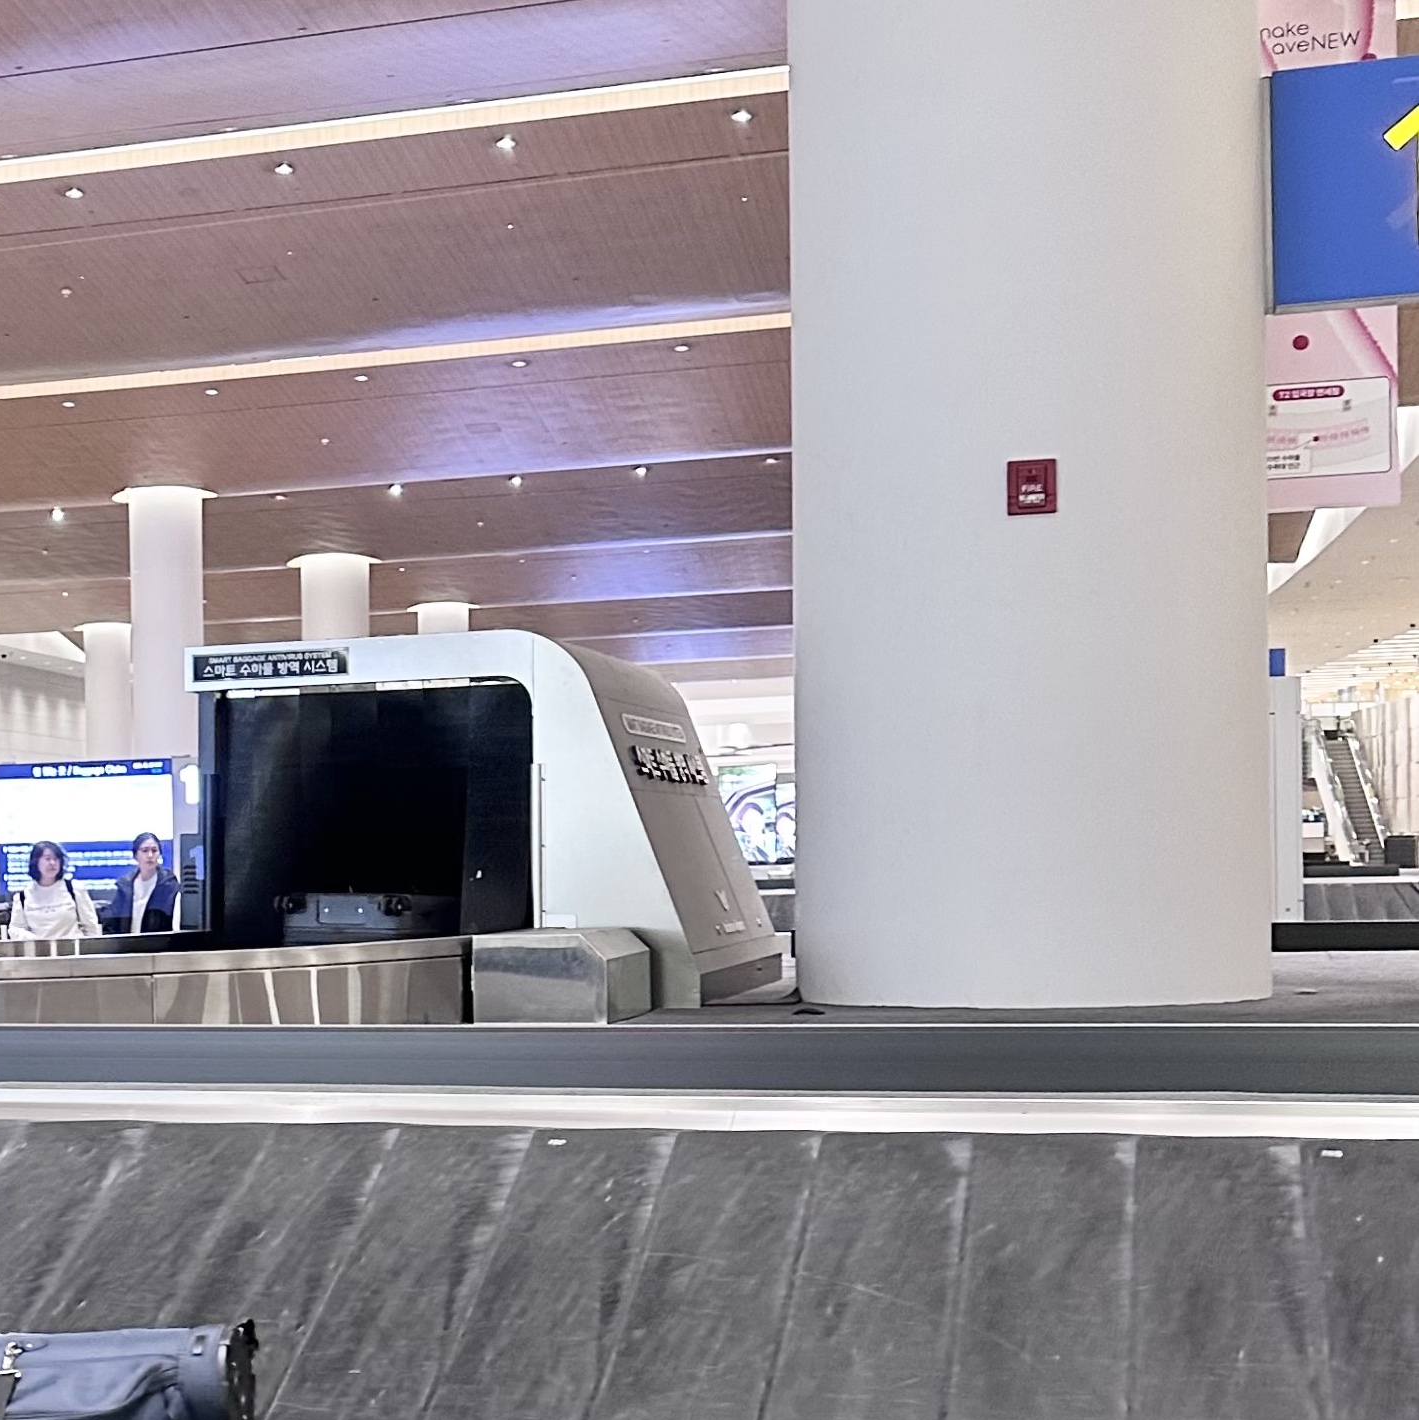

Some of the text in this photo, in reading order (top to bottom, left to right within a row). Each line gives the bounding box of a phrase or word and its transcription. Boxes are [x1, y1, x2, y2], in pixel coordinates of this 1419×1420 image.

[203, 658, 338, 678] 스마트 수하물 방역 시스템
